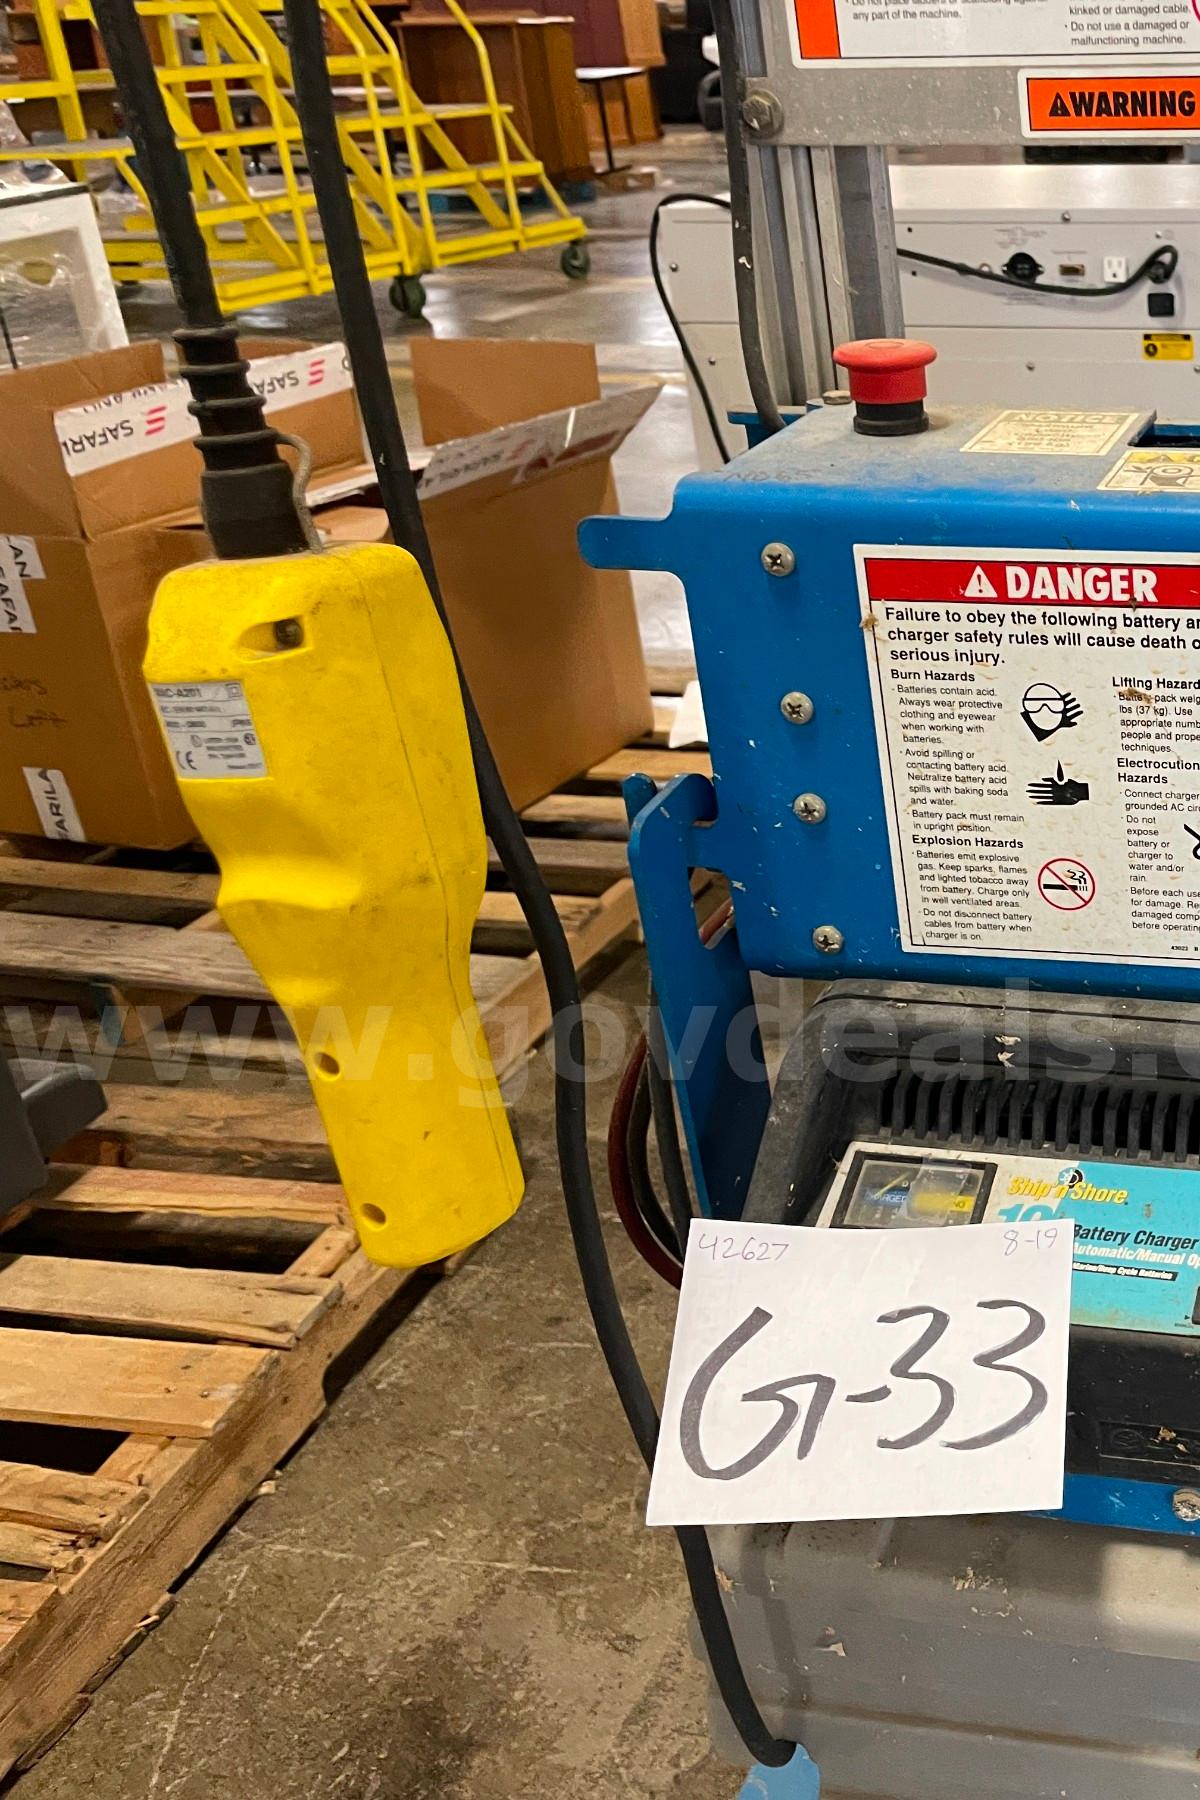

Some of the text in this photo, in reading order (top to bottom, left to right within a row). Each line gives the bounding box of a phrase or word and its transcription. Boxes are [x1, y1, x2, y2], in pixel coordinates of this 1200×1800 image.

[852, 8, 962, 21] any part of the machine.
[1068, 3, 1189, 17] kinked or damaged cable.
[1070, 19, 1190, 32] Do not use a damaged or
[1071, 33, 1183, 47] malfunctioning machine.
[1068, 90, 1196, 118] WARNING
[1012, 412, 1117, 423] NOTICE
[1005, 566, 1158, 603] DANGER
[885, 606, 941, 622] Failure
[945, 609, 962, 623] to
[966, 609, 1006, 628] obey
[1010, 610, 1037, 625] the
[1041, 611, 1117, 631] following
[1122, 613, 1181, 632] battery
[887, 627, 950, 645] charger
[954, 629, 1003, 647] safety
[1008, 630, 1049, 646] rules
[1053, 631, 1081, 646] will
[1086, 635, 1135, 648] cause
[1140, 634, 1187, 649] death
[890, 647, 1005, 666] serious injury.
[890, 668, 975, 682] Burn Hazards
[896, 683, 997, 697] Batteries contain acid.
[1112, 676, 1200, 691] Lifting Hazard
[898, 696, 1003, 710] Always wear protective
[1118, 691, 1153, 704] Batte
[1154, 693, 1177, 704] pack
[1119, 704, 1193, 717] lbs (37 kg). Use
[1116, 757, 1200, 771] Electrocution
[1117, 772, 1168, 784] Hazards
[1124, 788, 1163, 799] Connect
[1164, 791, 1200, 802] charger
[1124, 802, 1168, 812] grounded
[1170, 802, 1185, 812] AC
[911, 834, 1024, 849] Explosion Hazards
[698, 1228, 1058, 1260] 42627 8-19
[1074, 1224, 1200, 1251] Battery Charger
[1074, 1242, 1185, 1265] Automatic/Manual
[1117, 1266, 1138, 1276] Cycle
[1138, 1268, 1173, 1280] Batteries
[679, 1299, 1049, 1480] G-33
